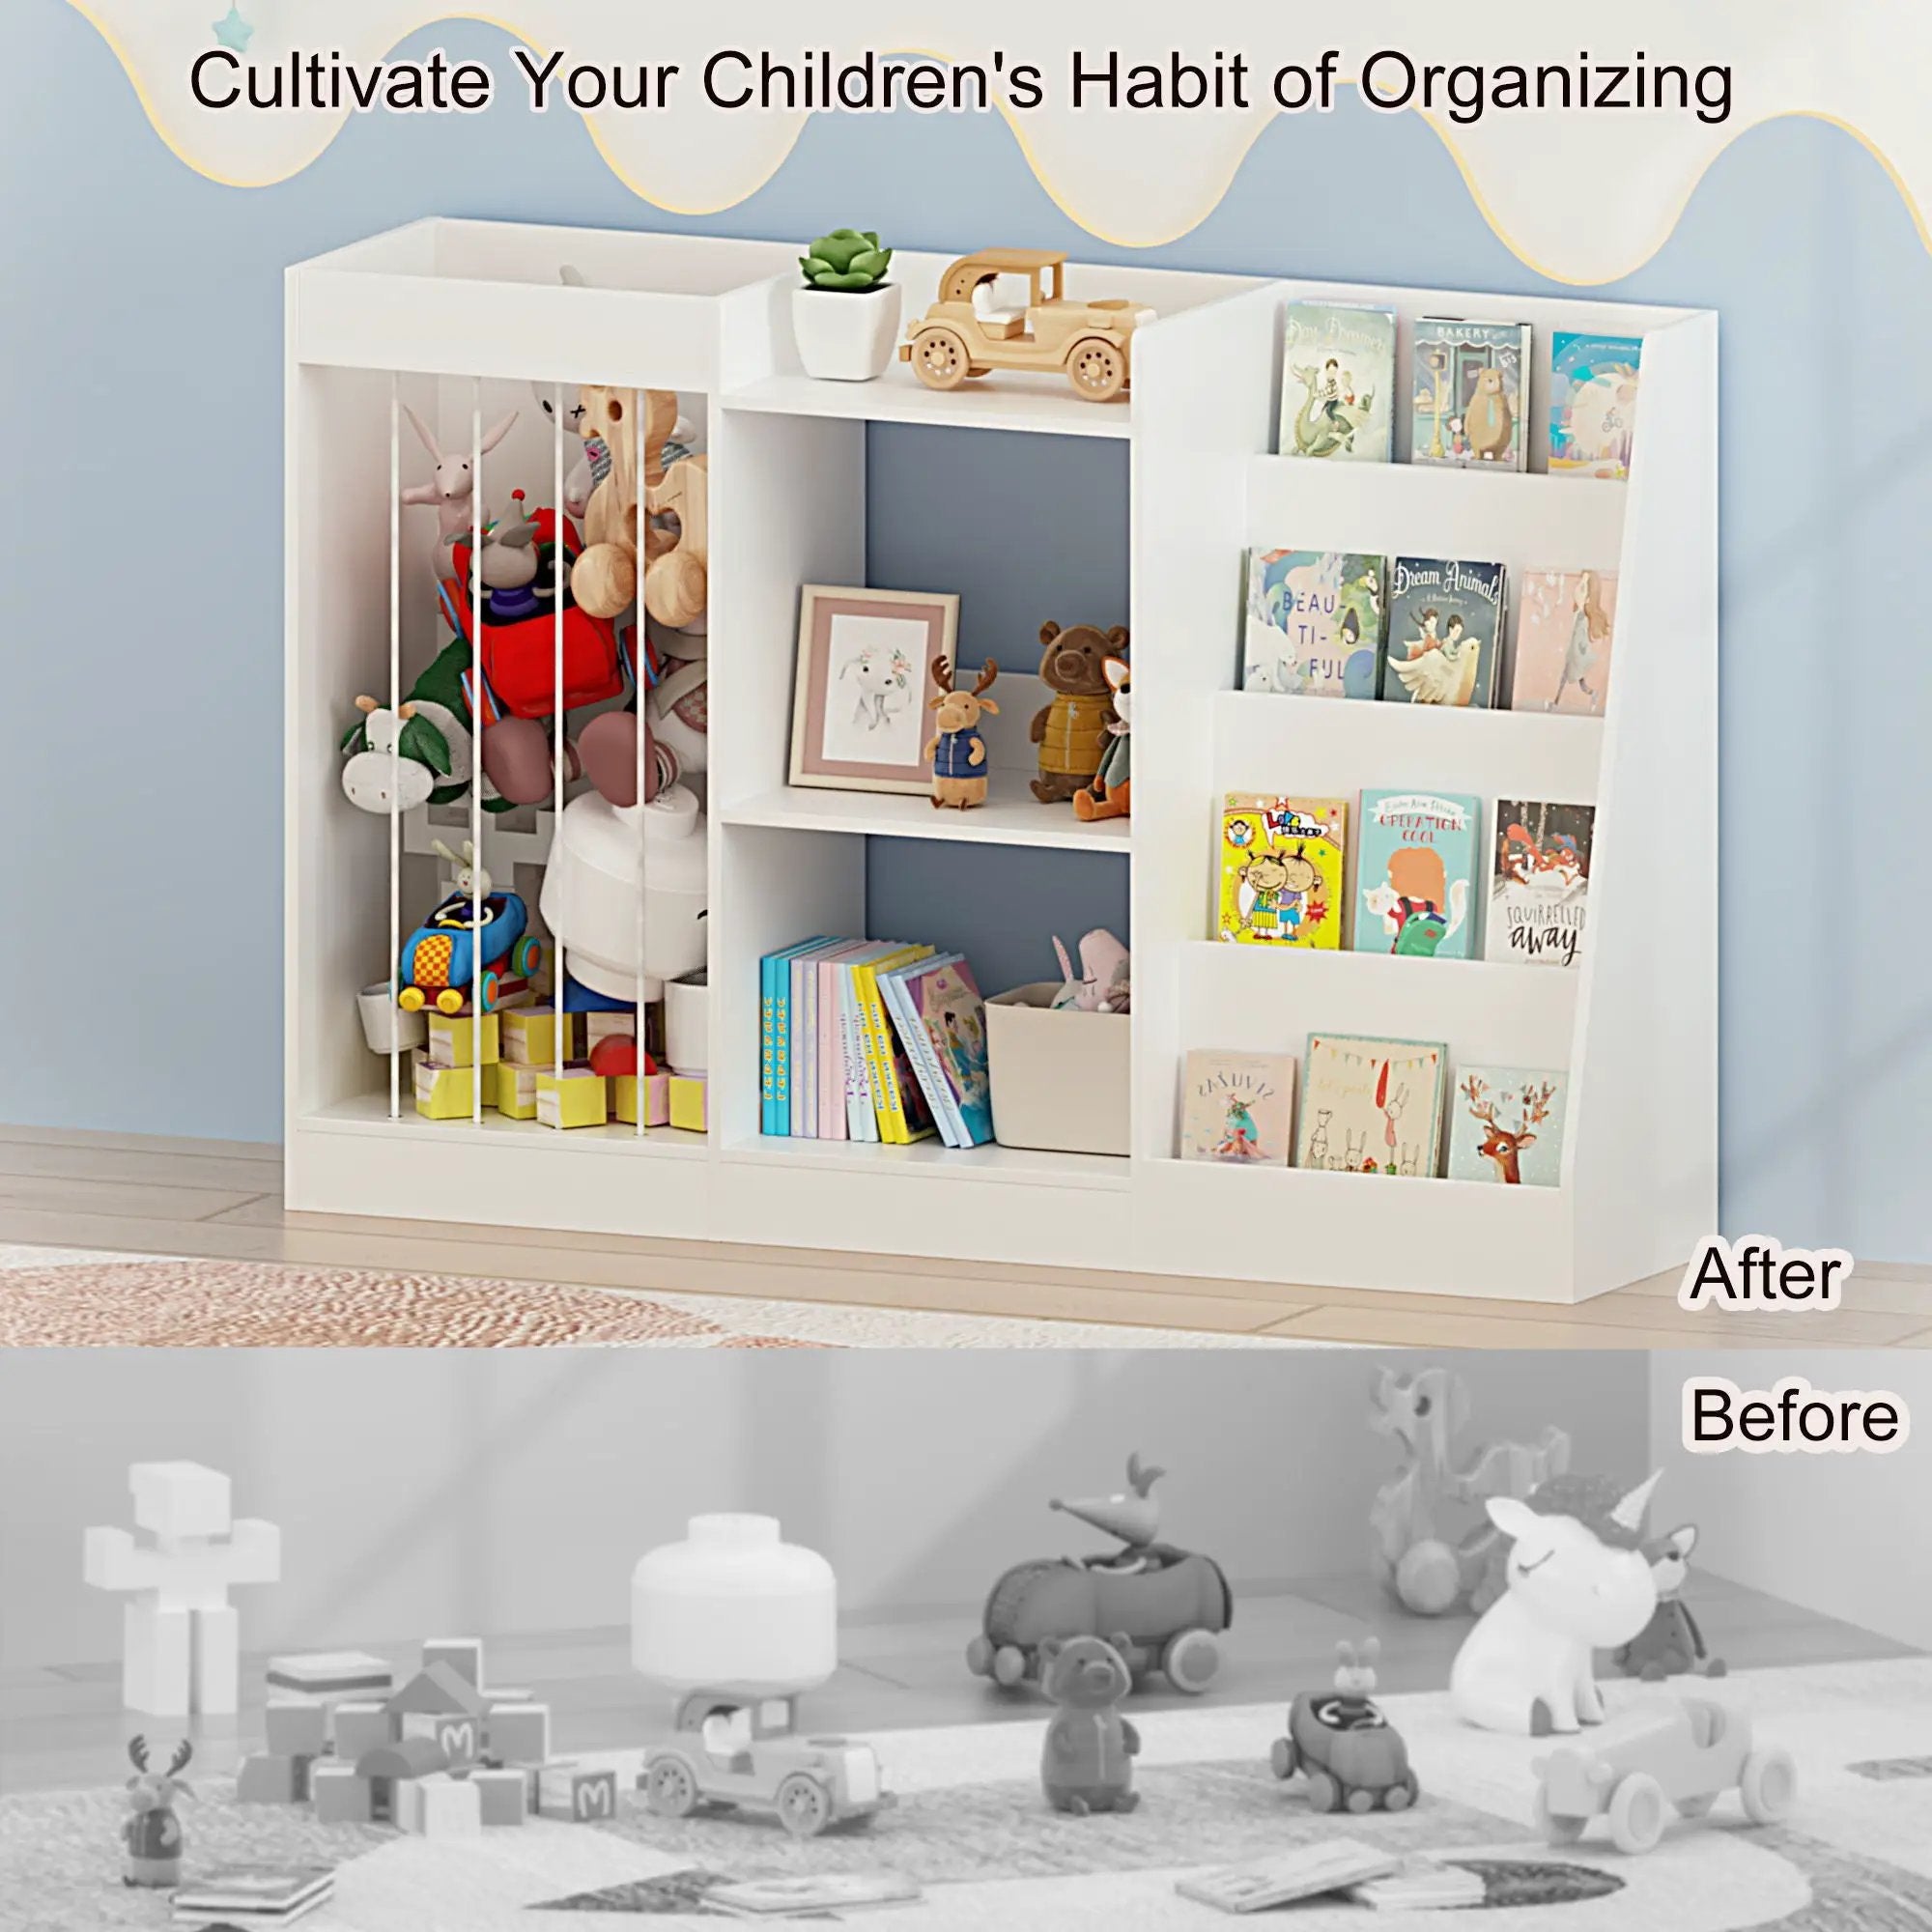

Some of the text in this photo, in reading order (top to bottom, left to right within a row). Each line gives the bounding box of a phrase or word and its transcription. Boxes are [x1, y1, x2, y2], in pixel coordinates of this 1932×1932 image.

[1436, 327, 1490, 339] BAKERY
[1391, 560, 1499, 606] Dream Animals
[1283, 591, 1347, 614] BEAU-
[1309, 658, 1346, 680] FUL
[1506, 904, 1586, 931] SQUIRRELLED
[1508, 924, 1582, 967] away
[440, 1722, 473, 1758] M
[579, 1779, 611, 1818] M
